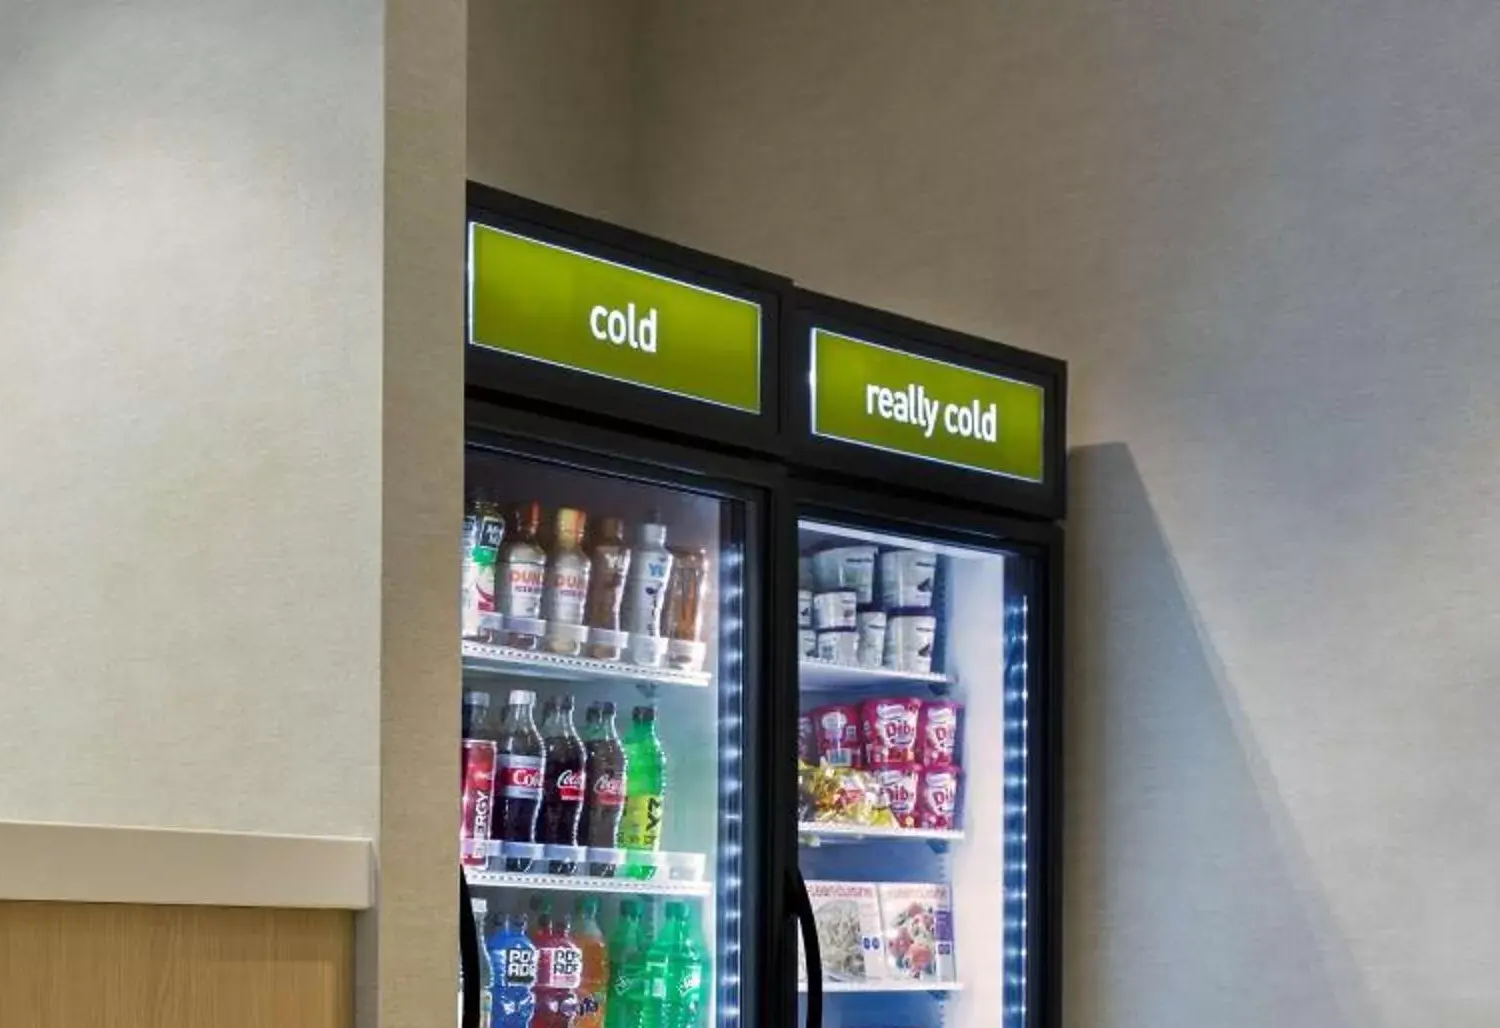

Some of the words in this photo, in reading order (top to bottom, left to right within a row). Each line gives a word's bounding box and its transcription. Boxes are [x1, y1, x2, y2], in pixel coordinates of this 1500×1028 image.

[590, 302, 657, 352] cold
[866, 383, 939, 438] really
[944, 399, 997, 442] cold
